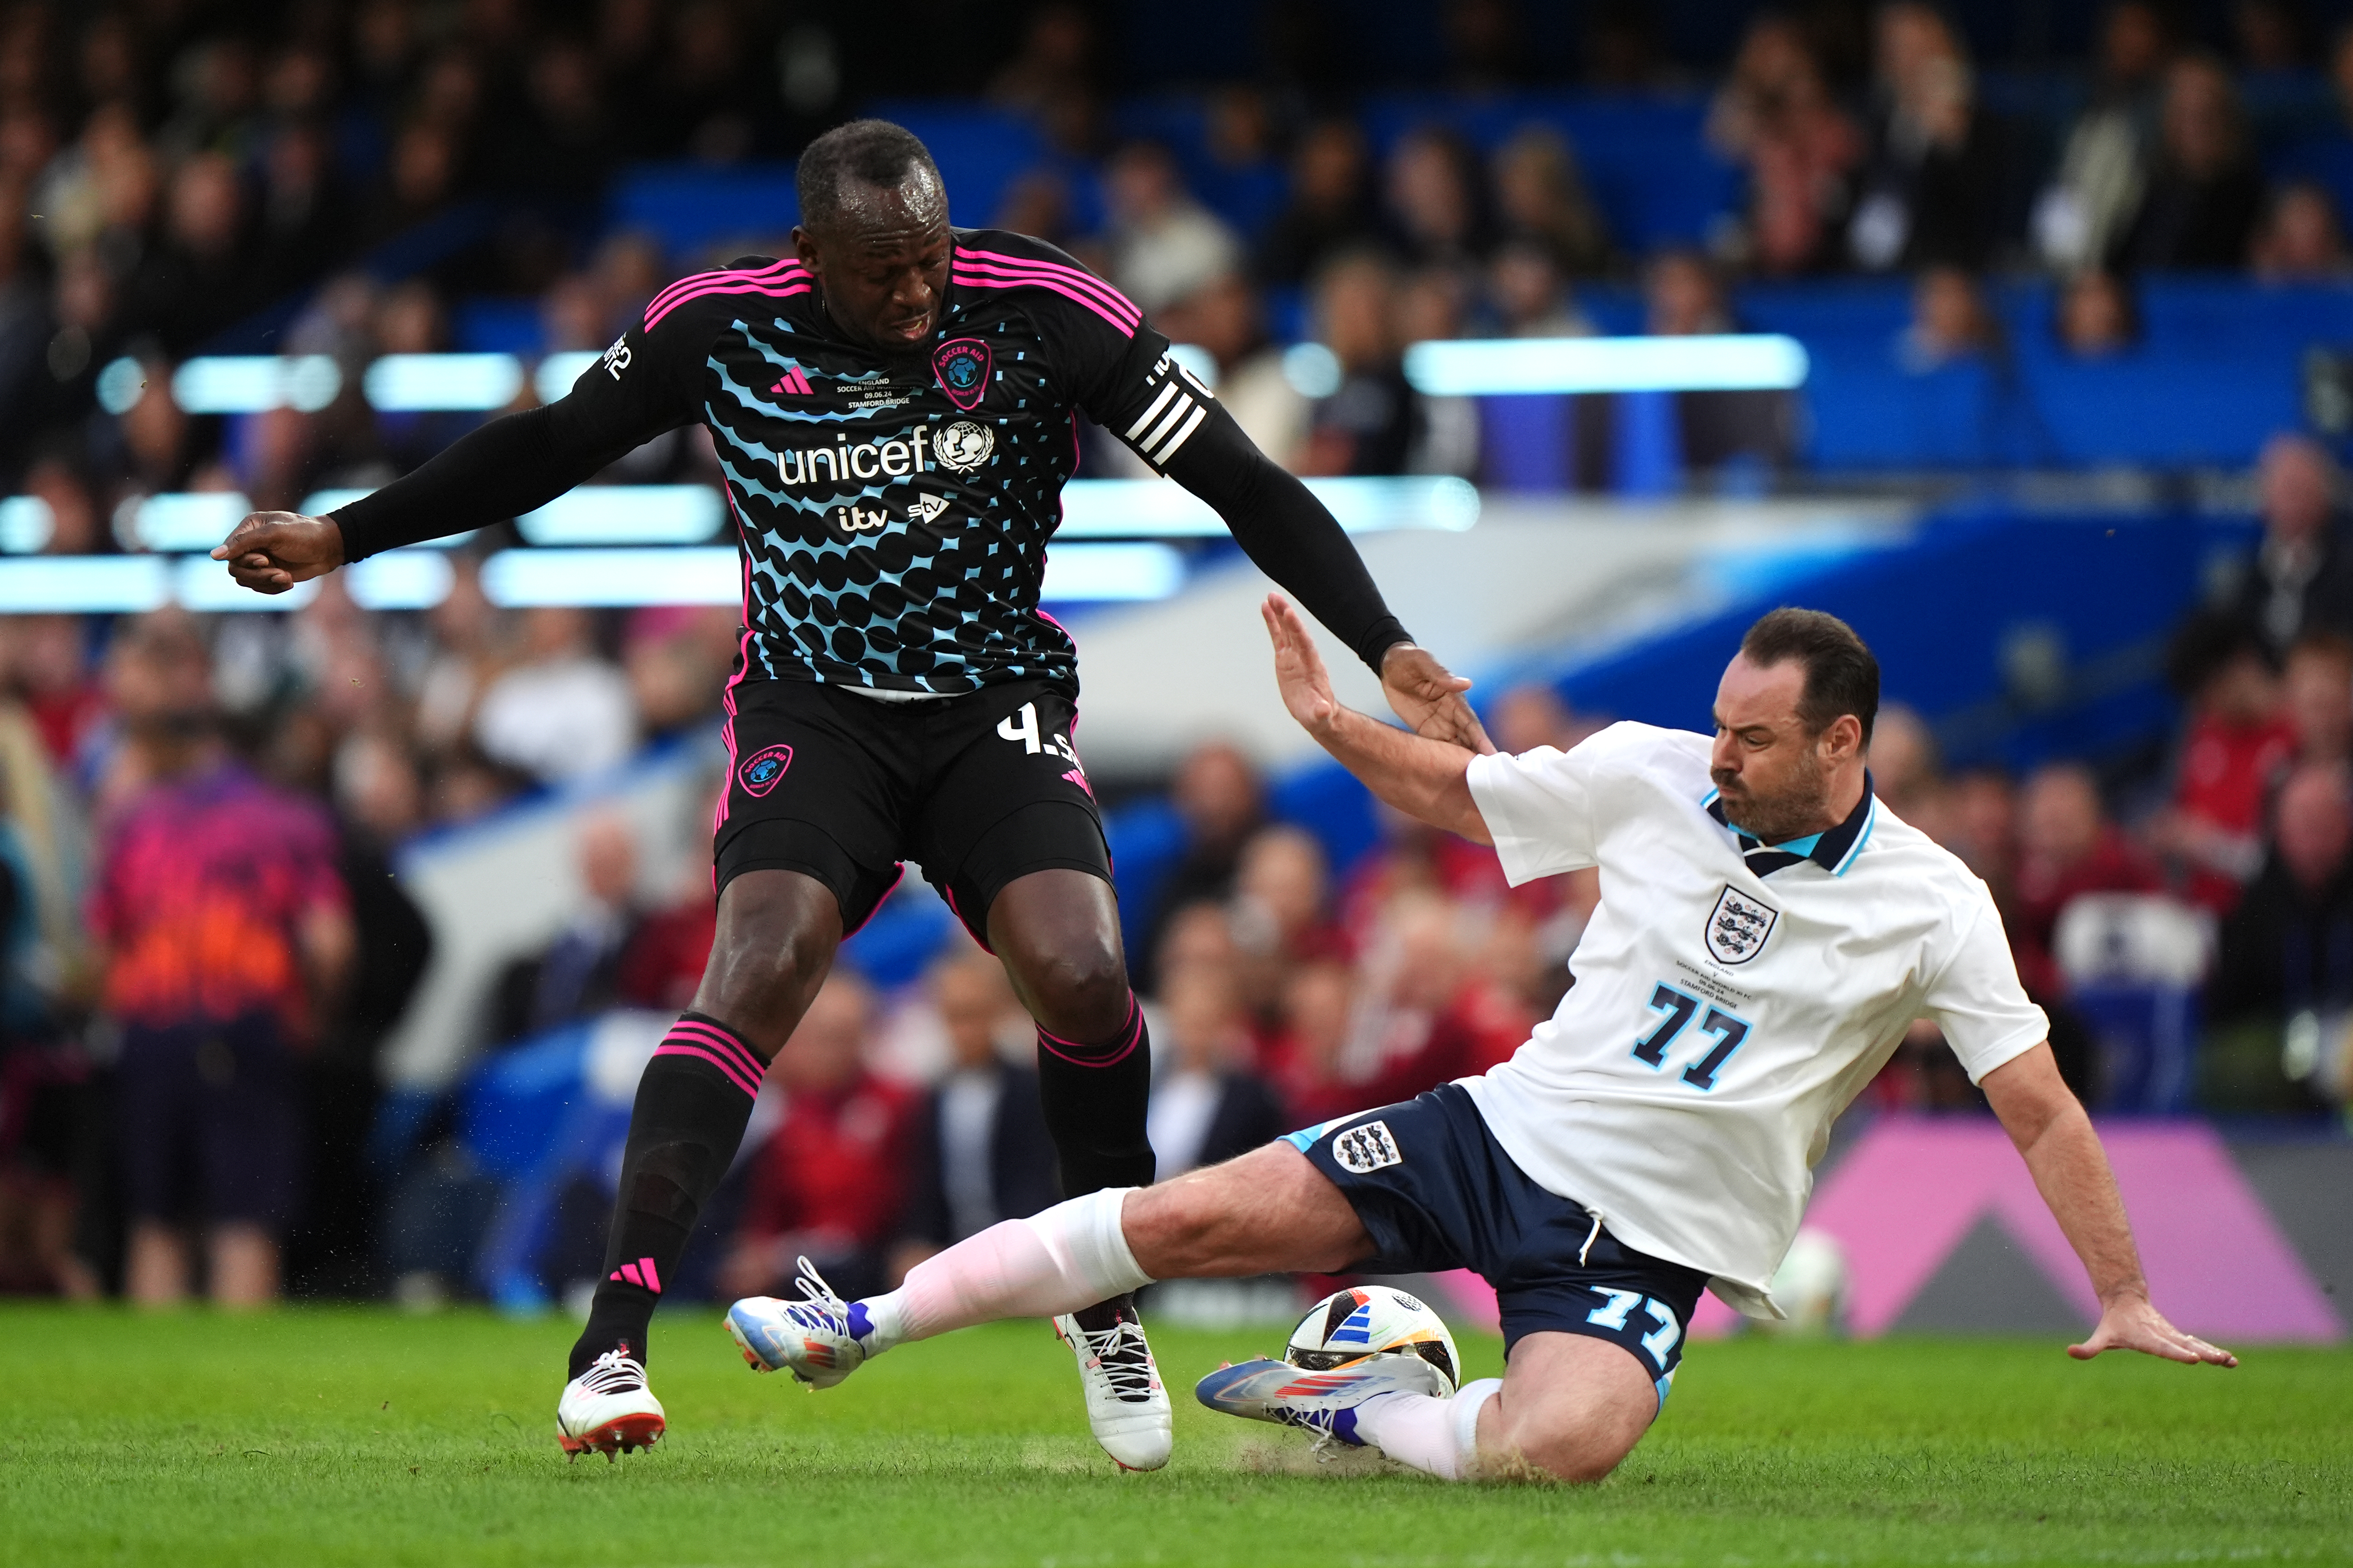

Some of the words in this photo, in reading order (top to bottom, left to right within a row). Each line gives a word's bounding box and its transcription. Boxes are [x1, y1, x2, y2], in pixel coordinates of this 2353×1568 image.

[938, 346, 969, 367] SOCCER
[970, 349, 985, 361] AID
[848, 400, 884, 409] STAMFORD
[886, 397, 910, 406] BRIDGE
[864, 391, 892, 399] 09.06.24
[777, 425, 928, 485] unicef
[838, 507, 888, 532] itv
[1704, 960, 1734, 976] ENGLAND
[1680, 979, 1714, 998] STAMFORD
[1715, 994, 1738, 1010] BRIDGE
[1630, 980, 1753, 1094] 77
[1585, 1285, 1681, 1371] 77
